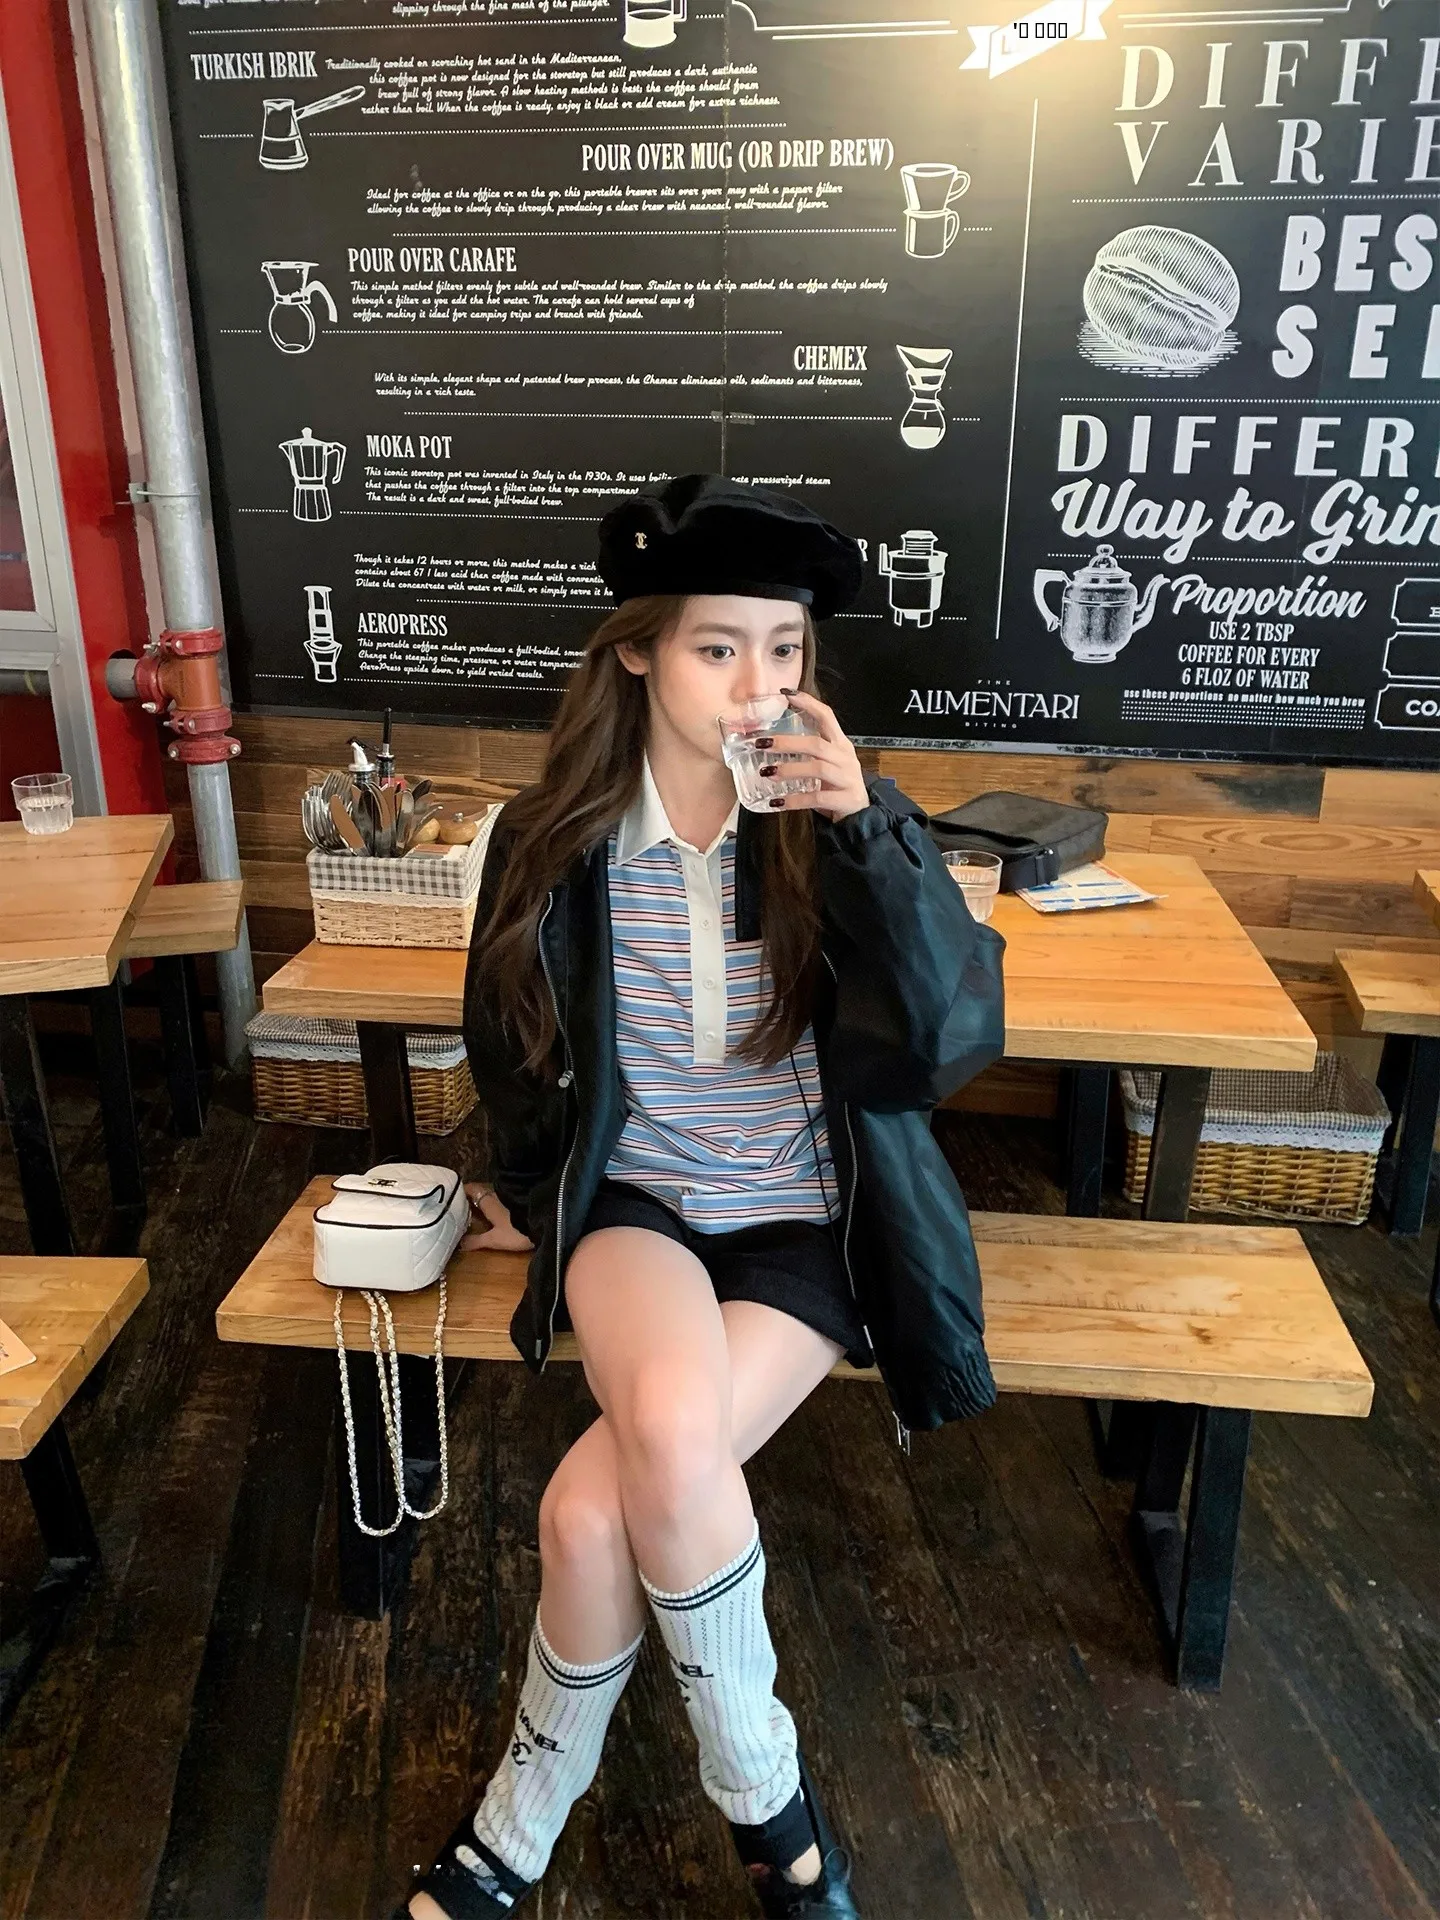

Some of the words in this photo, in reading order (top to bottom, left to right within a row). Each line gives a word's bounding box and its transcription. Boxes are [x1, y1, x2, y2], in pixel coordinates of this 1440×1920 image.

[392, 1, 429, 17] slipping
[432, 0, 467, 15] through
[190, 52, 265, 80] TURKISH
[269, 51, 318, 78] IBRIK
[383, 56, 414, 68] cooked
[431, 54, 474, 70] scorching
[388, 71, 418, 87] coffee
[471, 68, 510, 85] designed
[549, 70, 588, 83] stovetop
[627, 64, 671, 81] produces
[435, 89, 463, 101] strong
[533, 83, 567, 98] heating
[570, 81, 608, 94] methods
[663, 79, 696, 96] coffee
[698, 78, 731, 91] should
[360, 102, 389, 113] rather
[481, 99, 512, 115] coffee
[594, 97, 618, 109] black
[582, 144, 632, 171] POUR
[637, 143, 685, 170] OVER
[691, 142, 732, 170] MUG
[738, 140, 773, 172] (OR
[779, 139, 823, 168] DRIP
[829, 138, 894, 169] BREW)
[366, 187, 391, 199] Ideal
[411, 187, 440, 202] coffee
[472, 186, 500, 202] office
[582, 185, 622, 200] portable
[625, 184, 657, 196] brewer
[780, 185, 813, 198] paper
[815, 181, 842, 197] filter
[366, 202, 402, 217] allowing
[421, 202, 451, 217] coffee
[465, 201, 492, 216] slowly
[556, 200, 603, 215] producing
[614, 199, 638, 211] clear
[348, 248, 395, 272] POUR
[399, 247, 445, 273] OVER
[449, 247, 517, 272] CARAFE
[371, 280, 399, 294] simple
[402, 280, 433, 290] method
[435, 280, 463, 294] filters
[465, 280, 493, 295] evenly
[513, 279, 538, 290] subtle
[646, 279, 681, 290] Similar
[796, 278, 828, 293] coffee
[830, 278, 856, 292] drips
[859, 278, 888, 293] slowly
[351, 294, 384, 308] through
[395, 294, 419, 308] filter
[551, 293, 581, 308] carafe
[625, 293, 658, 304] several
[385, 307, 416, 321] making
[428, 307, 450, 318] ideal
[469, 309, 507, 322] camping
[793, 345, 868, 371] CHEMEX
[442, 372, 473, 386] elegant
[475, 372, 501, 386] shape
[522, 373, 561, 386] patented
[642, 373, 678, 384] Chemex
[750, 374, 794, 384] sediments
[375, 385, 411, 398] resulting
[366, 435, 416, 458] MOKA
[419, 435, 453, 459] POT
[383, 467, 408, 476] iconic
[410, 469, 444, 480] stovetop
[482, 469, 518, 478] invented
[531, 469, 554, 483] Italy
[750, 473, 803, 487] pressurized
[805, 476, 830, 484] steam
[383, 479, 411, 492] pushes
[429, 479, 457, 494] coffee
[460, 481, 492, 494] through
[502, 481, 526, 496] filter
[383, 492, 406, 501] result
[1051, 477, 1213, 564] Way
[1222, 487, 1294, 542] to
[353, 553, 382, 566] Though
[429, 555, 451, 565] hours
[510, 558, 540, 568] method
[542, 559, 568, 569] makes
[354, 567, 387, 575] contains
[389, 566, 410, 576] about
[491, 570, 518, 583] coffee
[355, 577, 379, 587] Dilute
[540, 584, 567, 598] simply
[1171, 574, 1366, 622] Proportion
[358, 612, 448, 636] AEROPRESS
[1209, 622, 1237, 640] USE
[1240, 623, 1250, 641] 2
[1256, 623, 1295, 643] TBSP
[375, 639, 409, 650] portable
[412, 640, 438, 653] coffee
[441, 641, 466, 651] maker
[468, 643, 505, 654] produces
[358, 649, 387, 662] Change
[404, 653, 437, 664] steeping
[1178, 644, 1233, 664] COFFEE
[1236, 646, 1266, 665] FOR
[1270, 647, 1320, 668] EVERY
[403, 664, 428, 674] upside
[466, 666, 486, 678] yield
[488, 668, 514, 677] varied
[1181, 668, 1191, 685] 6
[1235, 670, 1256, 687] OF
[1260, 670, 1310, 690] WATER
[903, 689, 1080, 720] ALIMENTARI
[1123, 689, 1140, 698] use
[1142, 689, 1168, 700] these
[1169, 691, 1224, 702] proportions
[1228, 693, 1239, 702] no
[1241, 693, 1273, 704] matter
[1275, 694, 1295, 704] how
[1297, 696, 1321, 706] much
[1323, 697, 1341, 708] you
[1342, 697, 1366, 708] brew
[1405, 699, 1440, 717] CO
